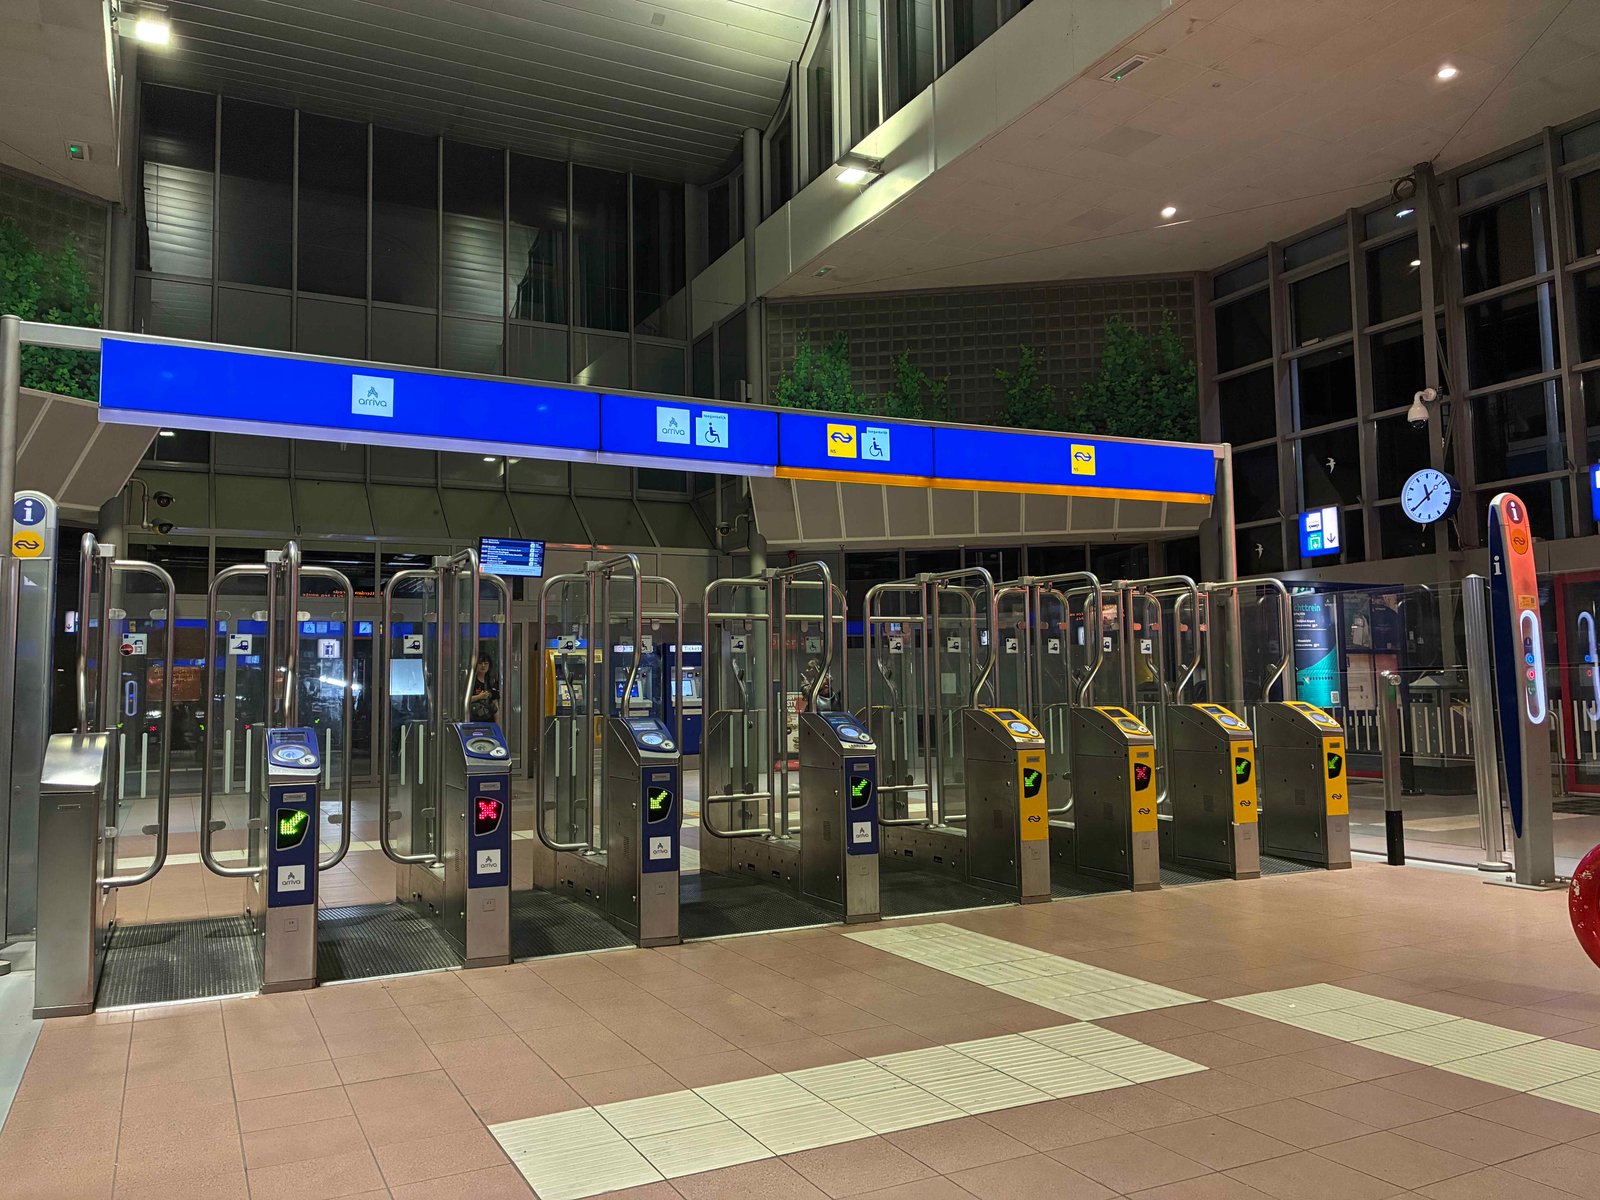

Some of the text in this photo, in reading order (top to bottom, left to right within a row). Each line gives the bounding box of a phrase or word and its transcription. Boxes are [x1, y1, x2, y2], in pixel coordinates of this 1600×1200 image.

[358, 397, 387, 407] arriva
[661, 427, 686, 436] arriva
[480, 861, 498, 869] arriva
[281, 877, 301, 886] arriva
